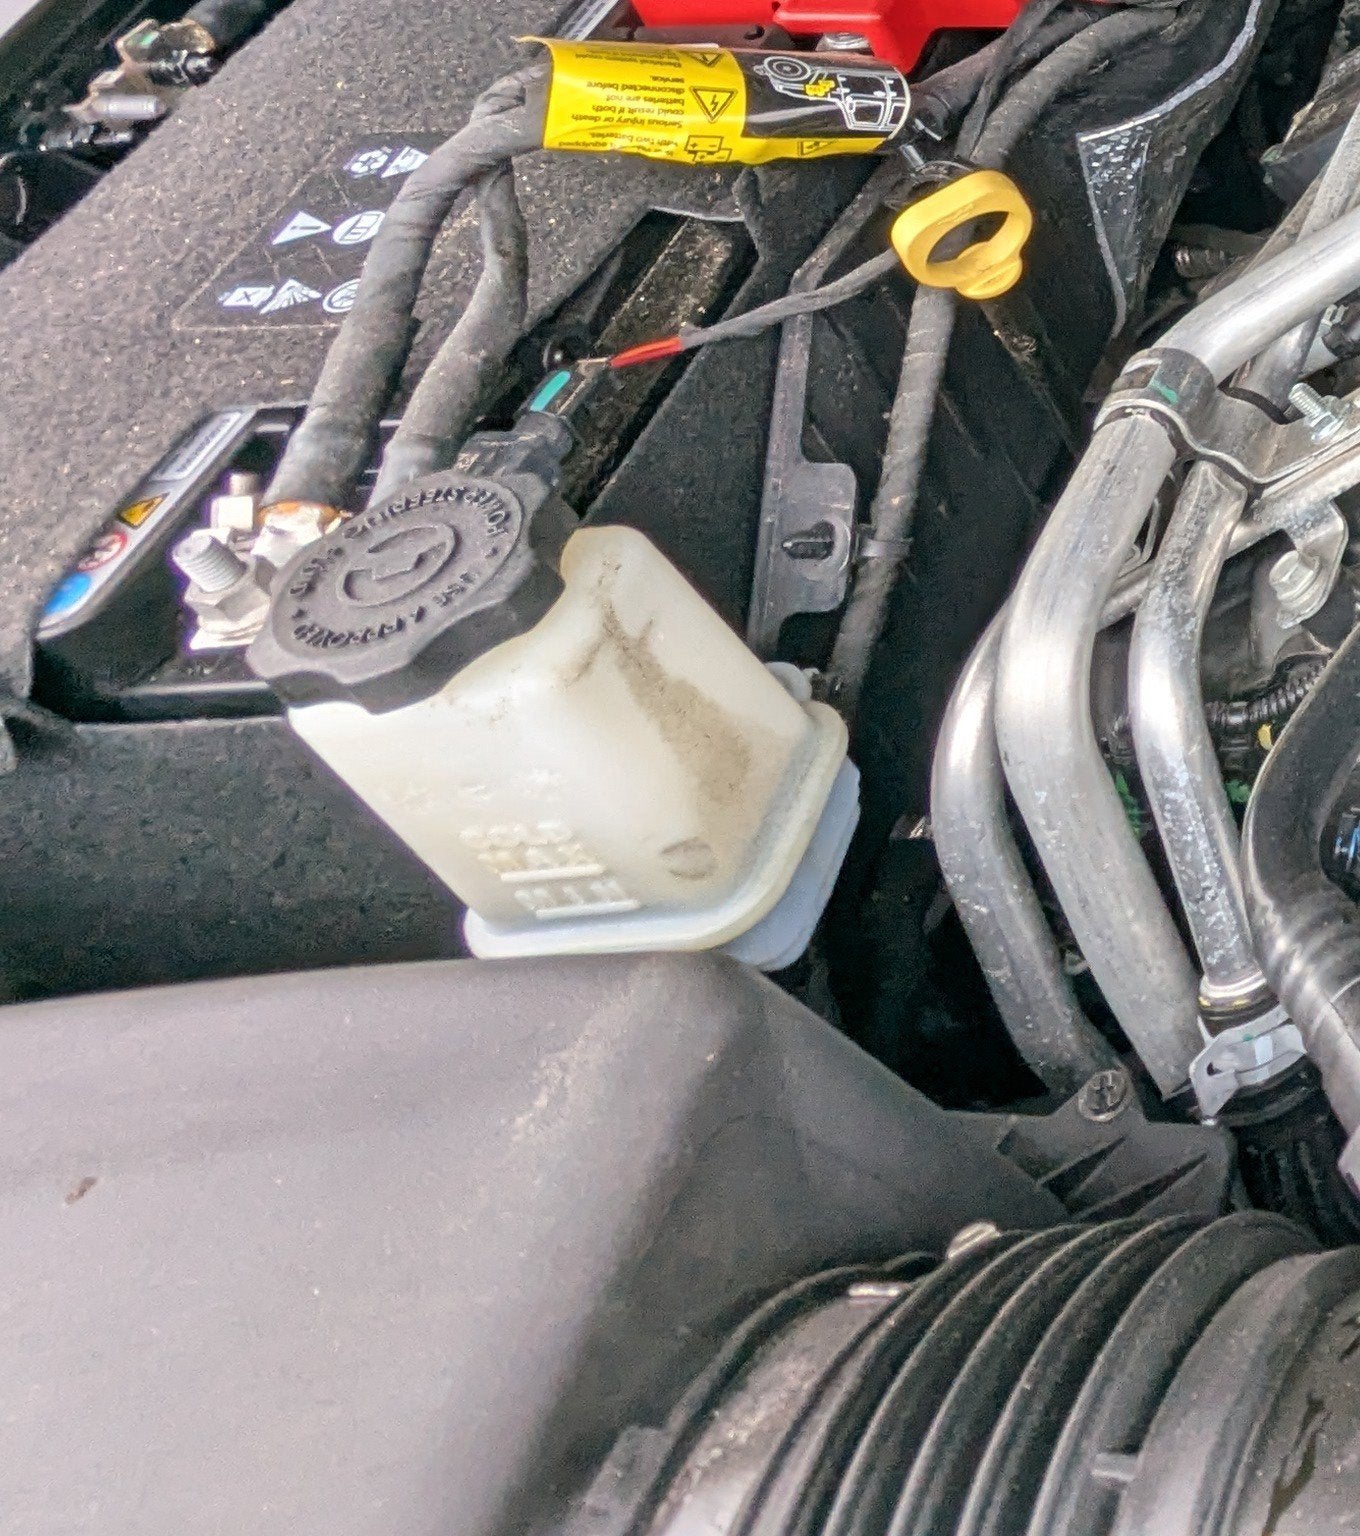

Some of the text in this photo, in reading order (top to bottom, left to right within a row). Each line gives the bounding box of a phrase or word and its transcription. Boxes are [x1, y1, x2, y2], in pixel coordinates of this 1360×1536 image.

[587, 81, 685, 95] disconnected before
[643, 96, 685, 106] batteries
[592, 104, 616, 114] both
[628, 105, 655, 114] result
[658, 108, 685, 117] could
[571, 113, 601, 122] death
[616, 115, 645, 126] injury
[648, 119, 682, 128] Serious
